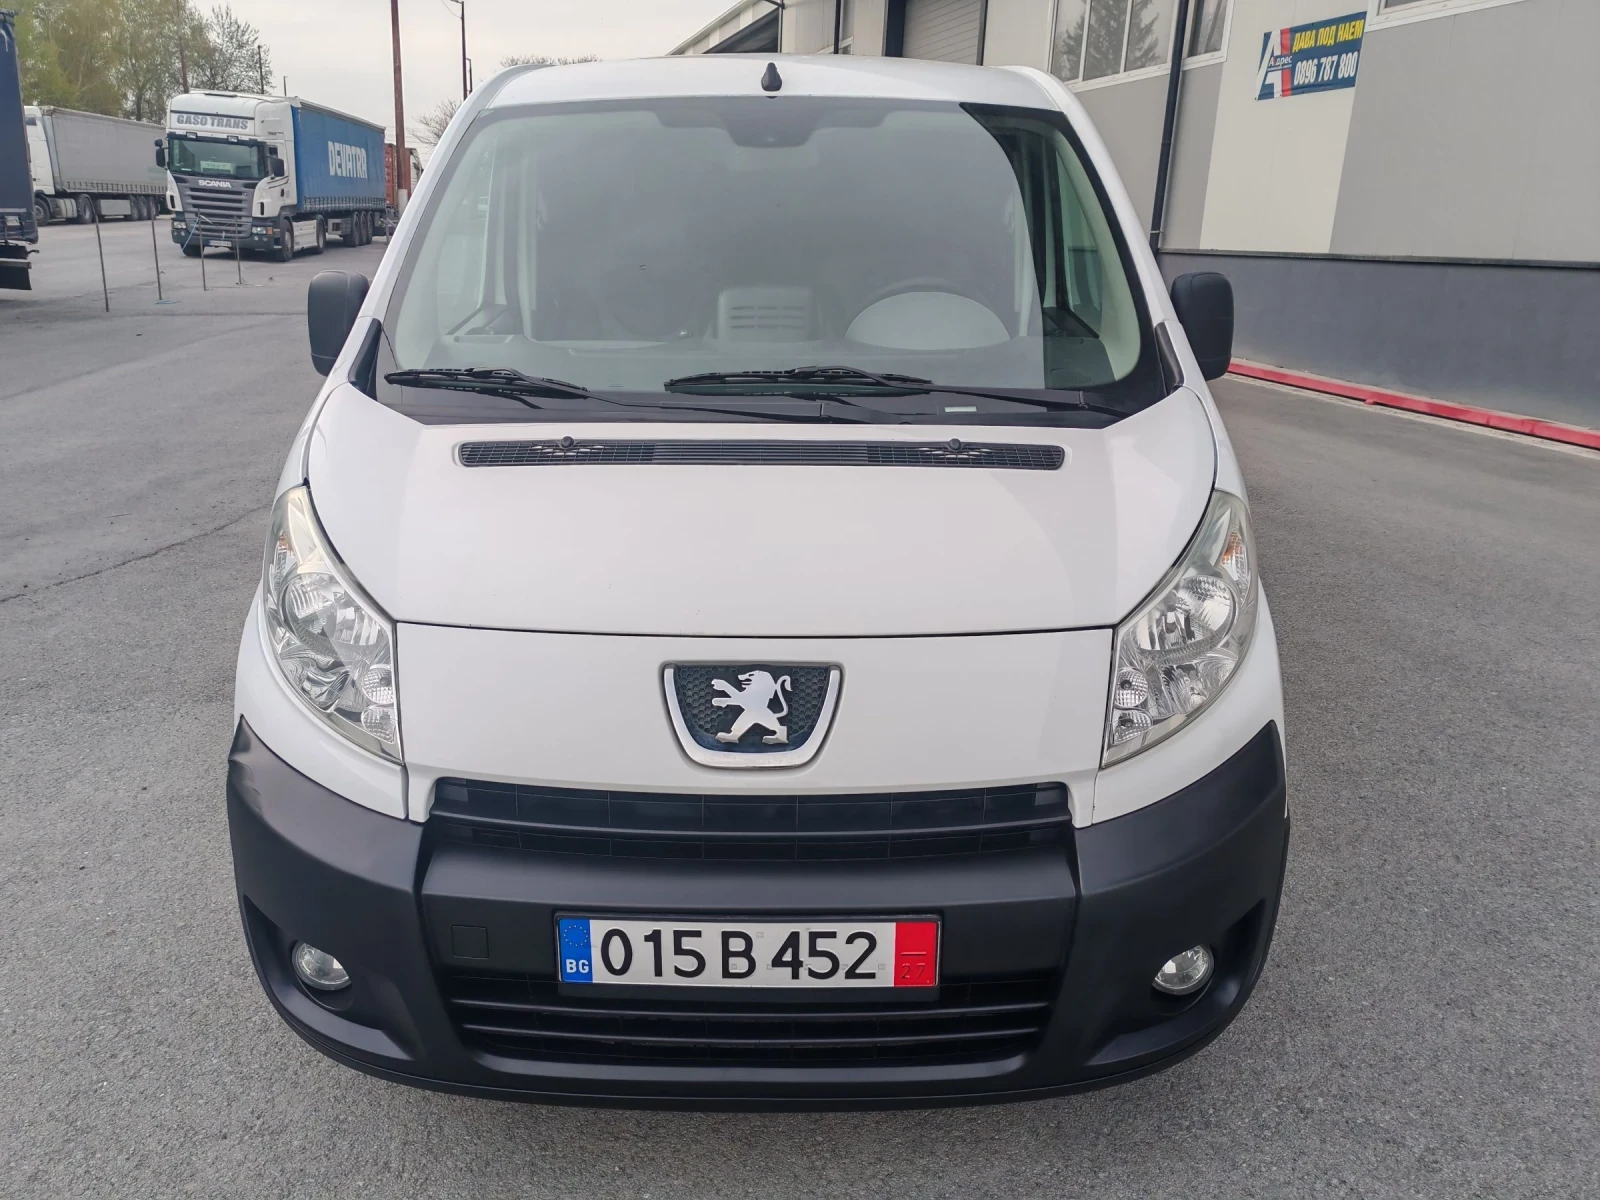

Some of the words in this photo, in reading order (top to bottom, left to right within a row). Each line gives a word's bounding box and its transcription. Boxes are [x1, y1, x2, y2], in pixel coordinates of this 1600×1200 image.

[1292, 30, 1316, 53] ДАВА
[1317, 26, 1337, 46] ПОД
[1337, 19, 1364, 42] НАЕМ
[1294, 58, 1318, 85] 0896
[1318, 55, 1338, 82] 787
[1338, 51, 1358, 79] 800
[177, 114, 208, 126] GASO
[210, 118, 248, 130] TRANS
[327, 141, 367, 179] DEVATRA
[198, 179, 231, 188] SCANIA
[566, 959, 589, 973] BG
